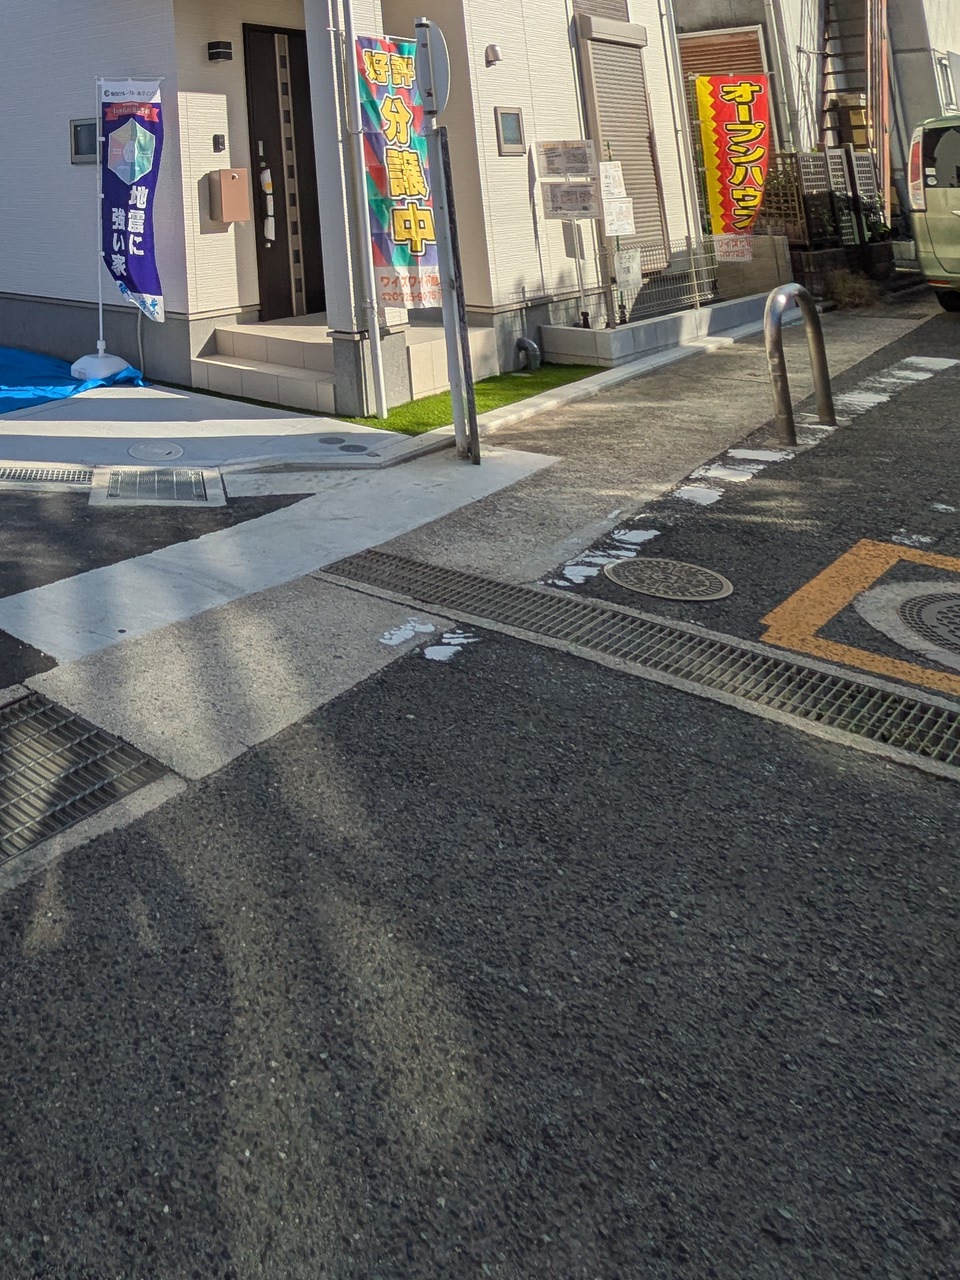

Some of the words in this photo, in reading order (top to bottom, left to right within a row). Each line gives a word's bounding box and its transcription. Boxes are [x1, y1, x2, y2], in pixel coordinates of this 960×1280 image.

[381, 96, 437, 253] 分譲中
[111, 207, 127, 276] 強い家
[127, 185, 149, 256] 地震に
